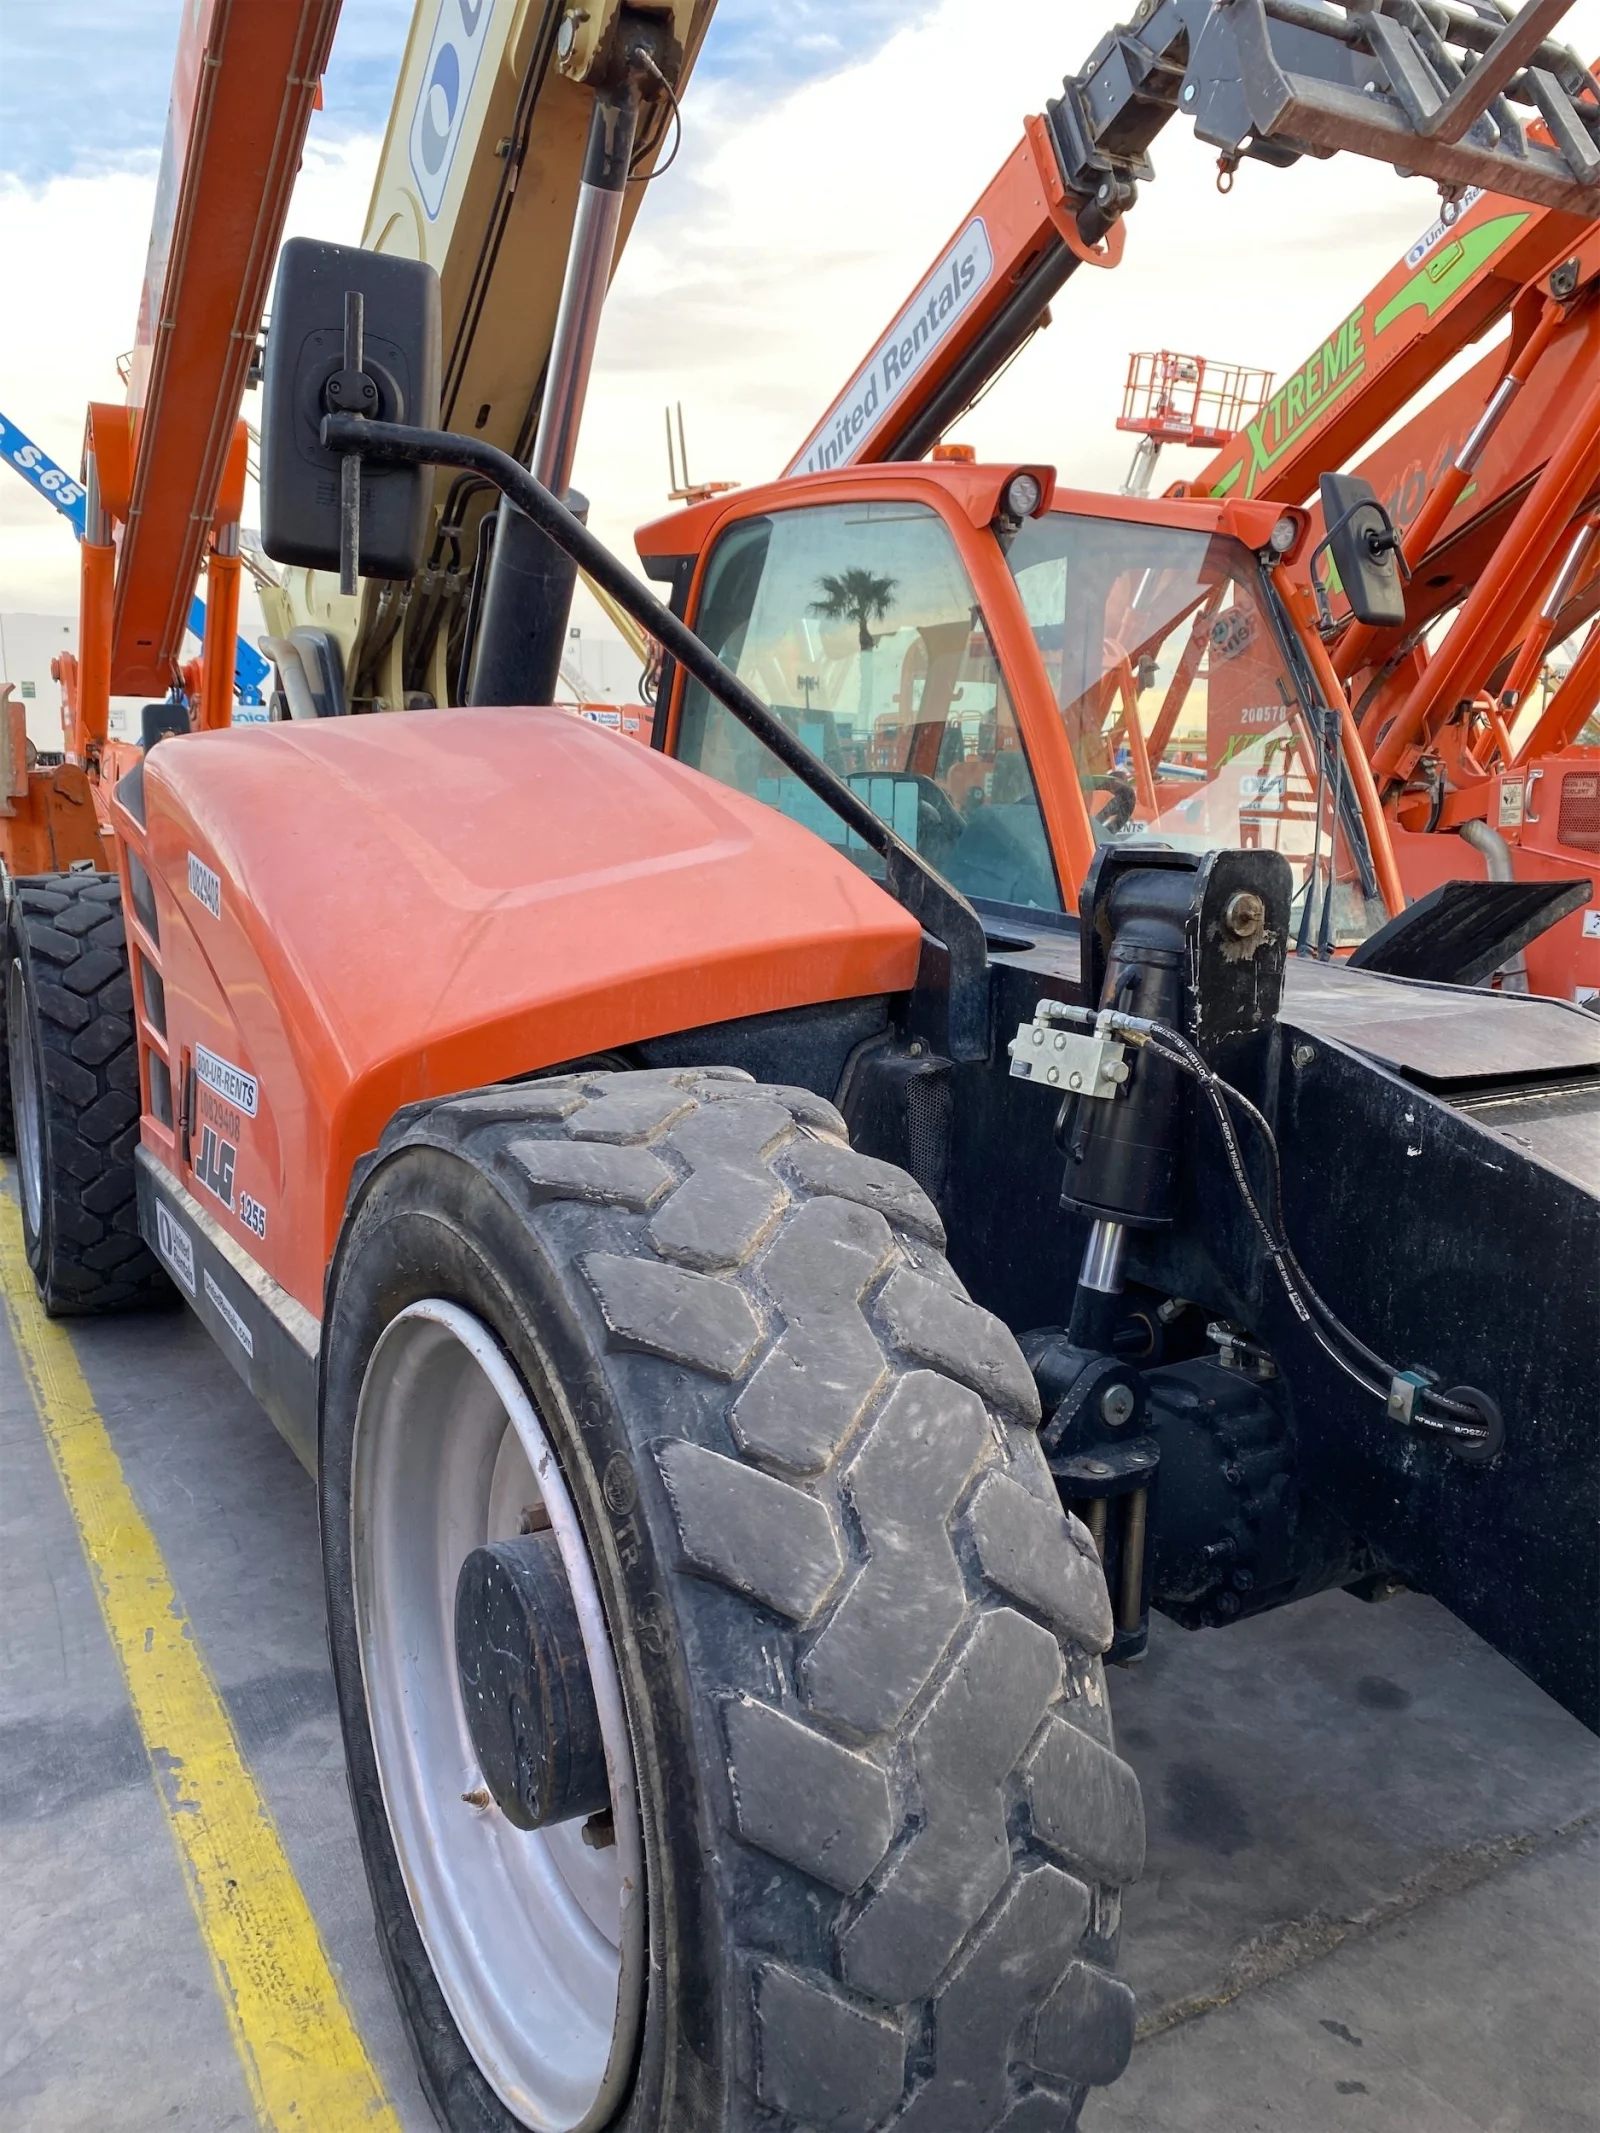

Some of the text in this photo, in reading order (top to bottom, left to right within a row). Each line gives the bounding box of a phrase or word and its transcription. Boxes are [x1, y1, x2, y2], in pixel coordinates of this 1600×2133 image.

[808, 252, 977, 474] United Rentals
[1245, 305, 1366, 499] XTREME
[13, 445, 85, 505] S-65
[1241, 705, 1287, 724] 200578
[197, 1053, 254, 1107] 800-UR-RENTS
[195, 1123, 236, 1210] JLG
[171, 1223, 190, 1262] United
[240, 1191, 266, 1240] 1255
[1413, 1414, 1444, 1428] www.pa
